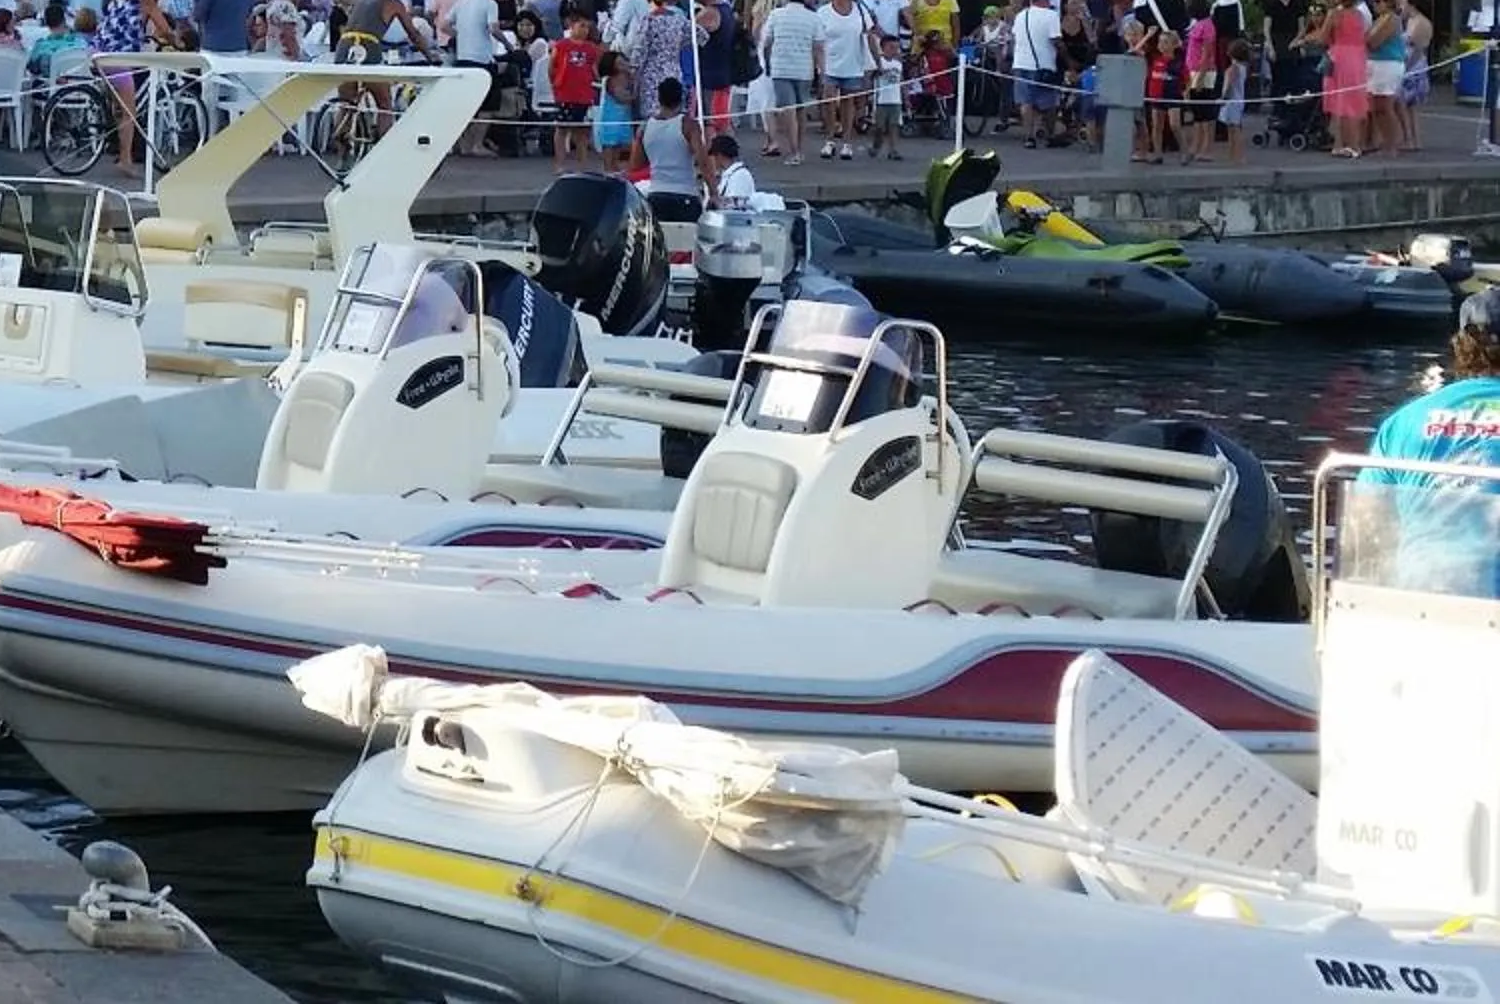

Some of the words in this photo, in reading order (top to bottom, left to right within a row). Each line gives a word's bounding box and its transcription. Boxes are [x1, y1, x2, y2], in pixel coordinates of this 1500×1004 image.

[601, 207, 638, 322] MERCURY
[513, 279, 536, 359] ERCURY
[1339, 816, 1383, 848] MAR
[1394, 827, 1418, 853] CO
[1315, 958, 1395, 992] MAR
[1399, 966, 1440, 995] CO
